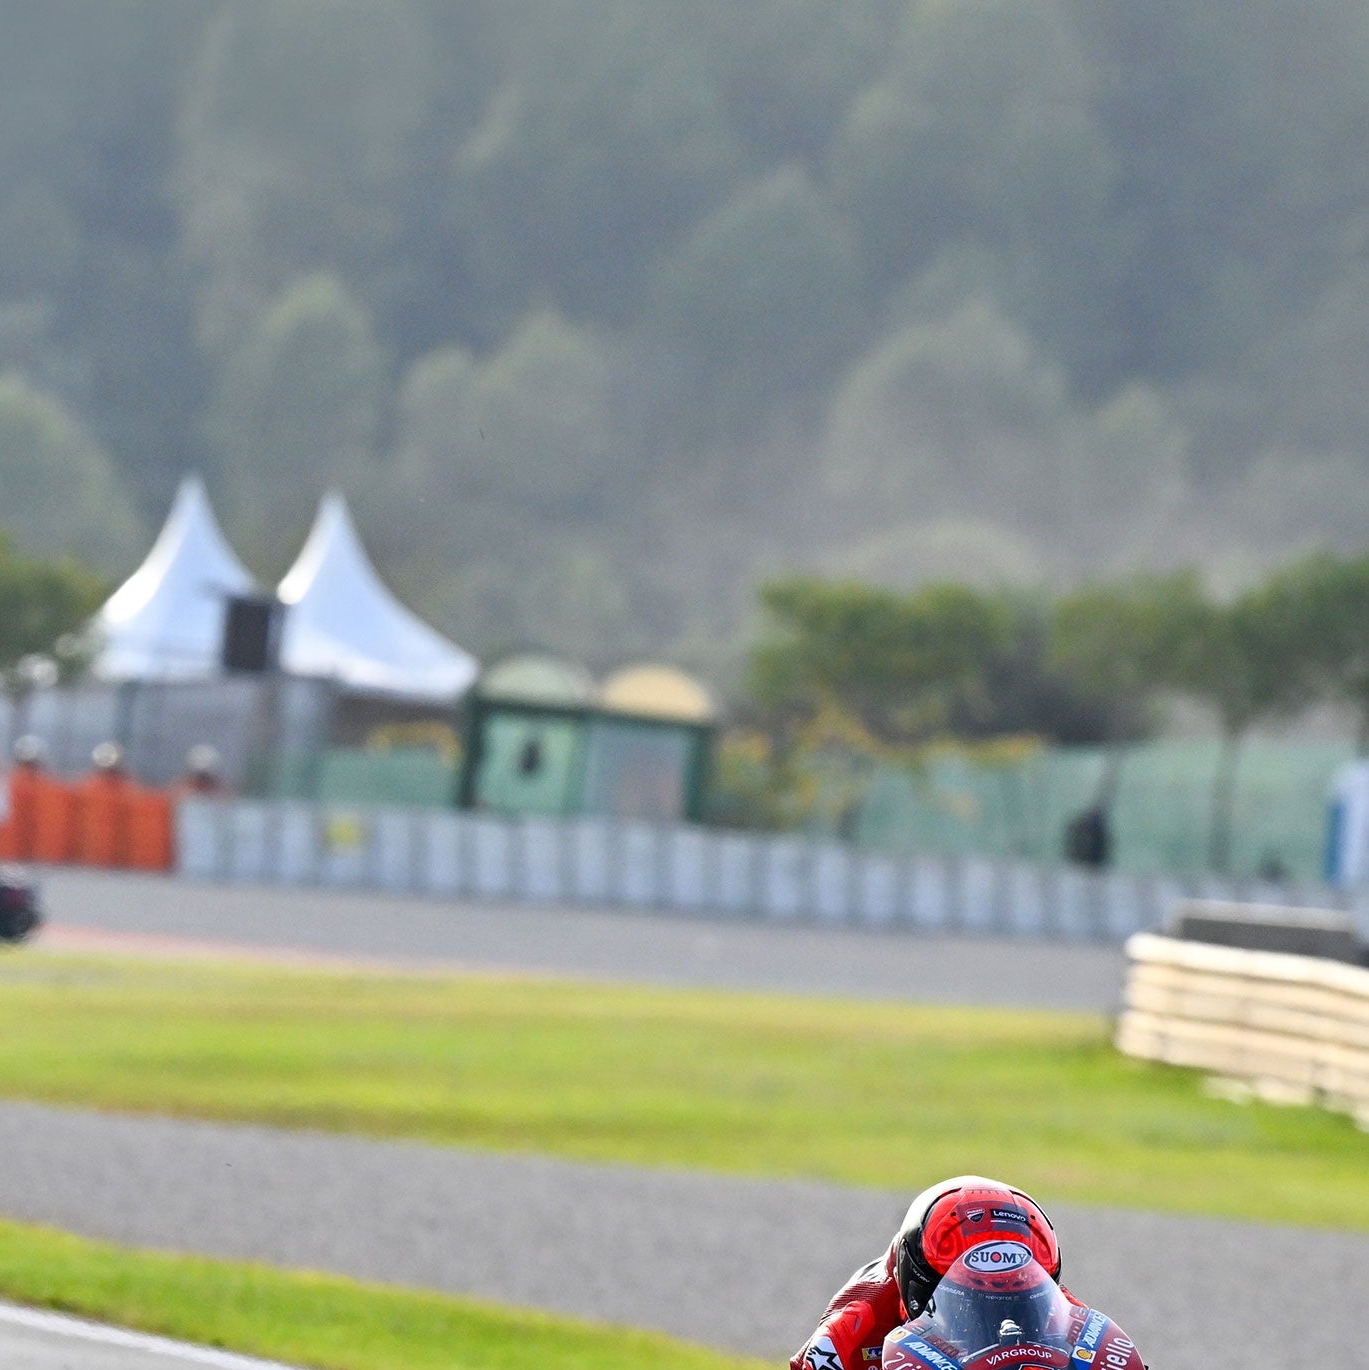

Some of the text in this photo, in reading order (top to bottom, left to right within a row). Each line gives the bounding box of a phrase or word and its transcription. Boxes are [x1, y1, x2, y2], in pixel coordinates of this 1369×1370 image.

[992, 1210, 1027, 1222] Lenovo
[971, 1251, 1028, 1265] SUOMY
[986, 1348, 1052, 1366] VARGROUP
